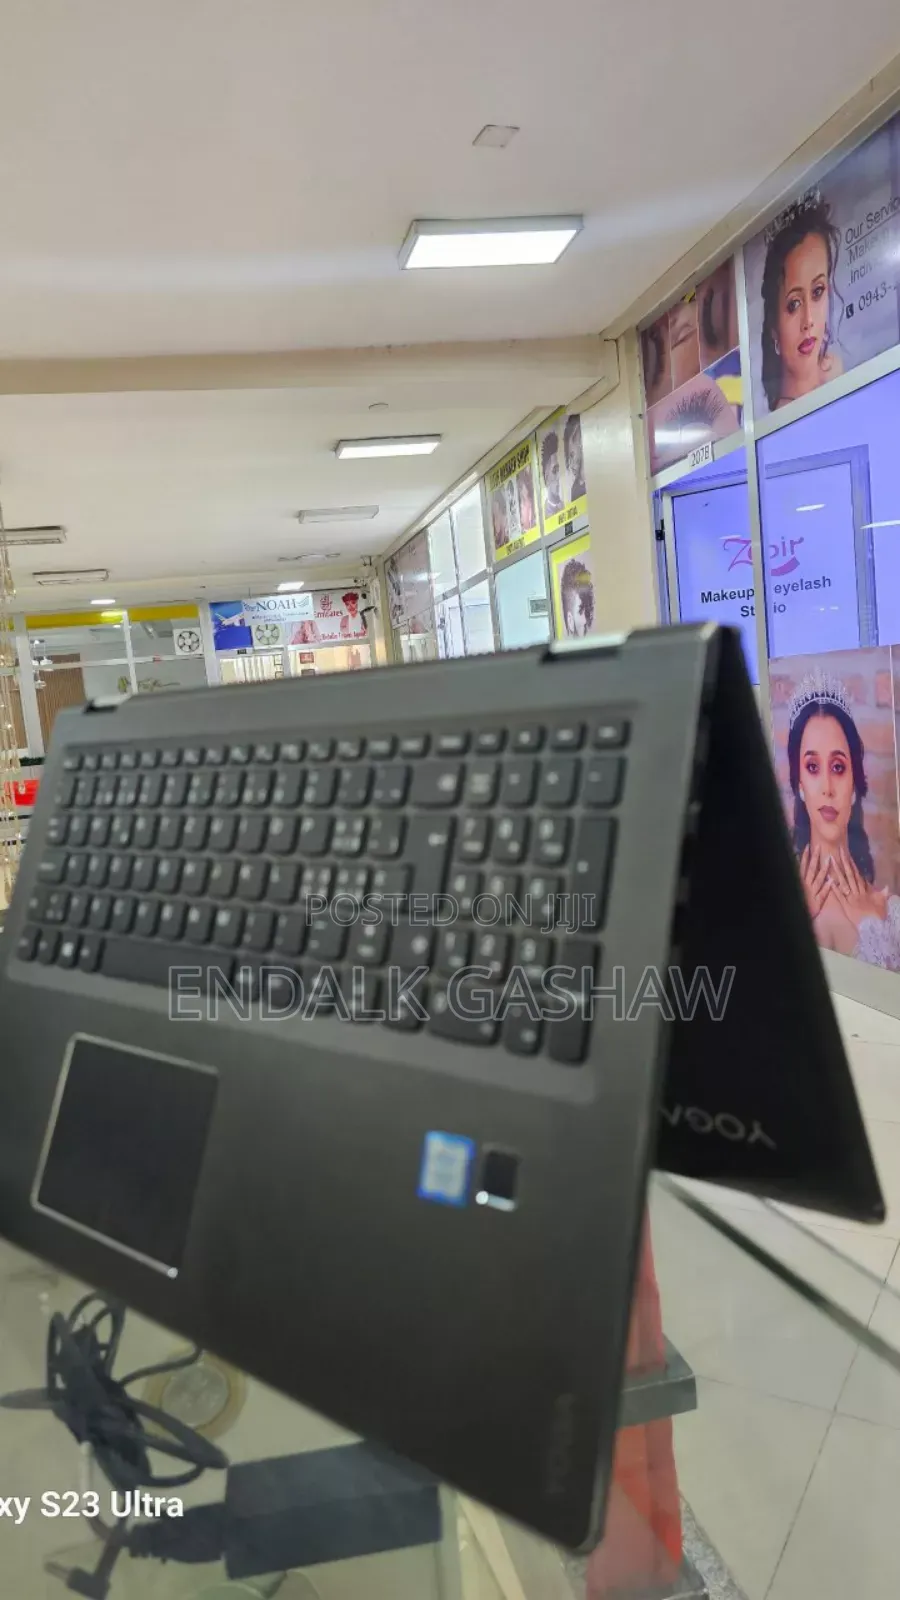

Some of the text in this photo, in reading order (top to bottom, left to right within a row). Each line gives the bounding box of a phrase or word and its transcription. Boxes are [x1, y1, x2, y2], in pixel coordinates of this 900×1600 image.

[845, 221, 864, 245] Our
[858, 281, 898, 311] 0943-
[701, 576, 832, 604] Makeup eyelash
[256, 598, 297, 611] NOAH
[740, 602, 787, 618] Stio
